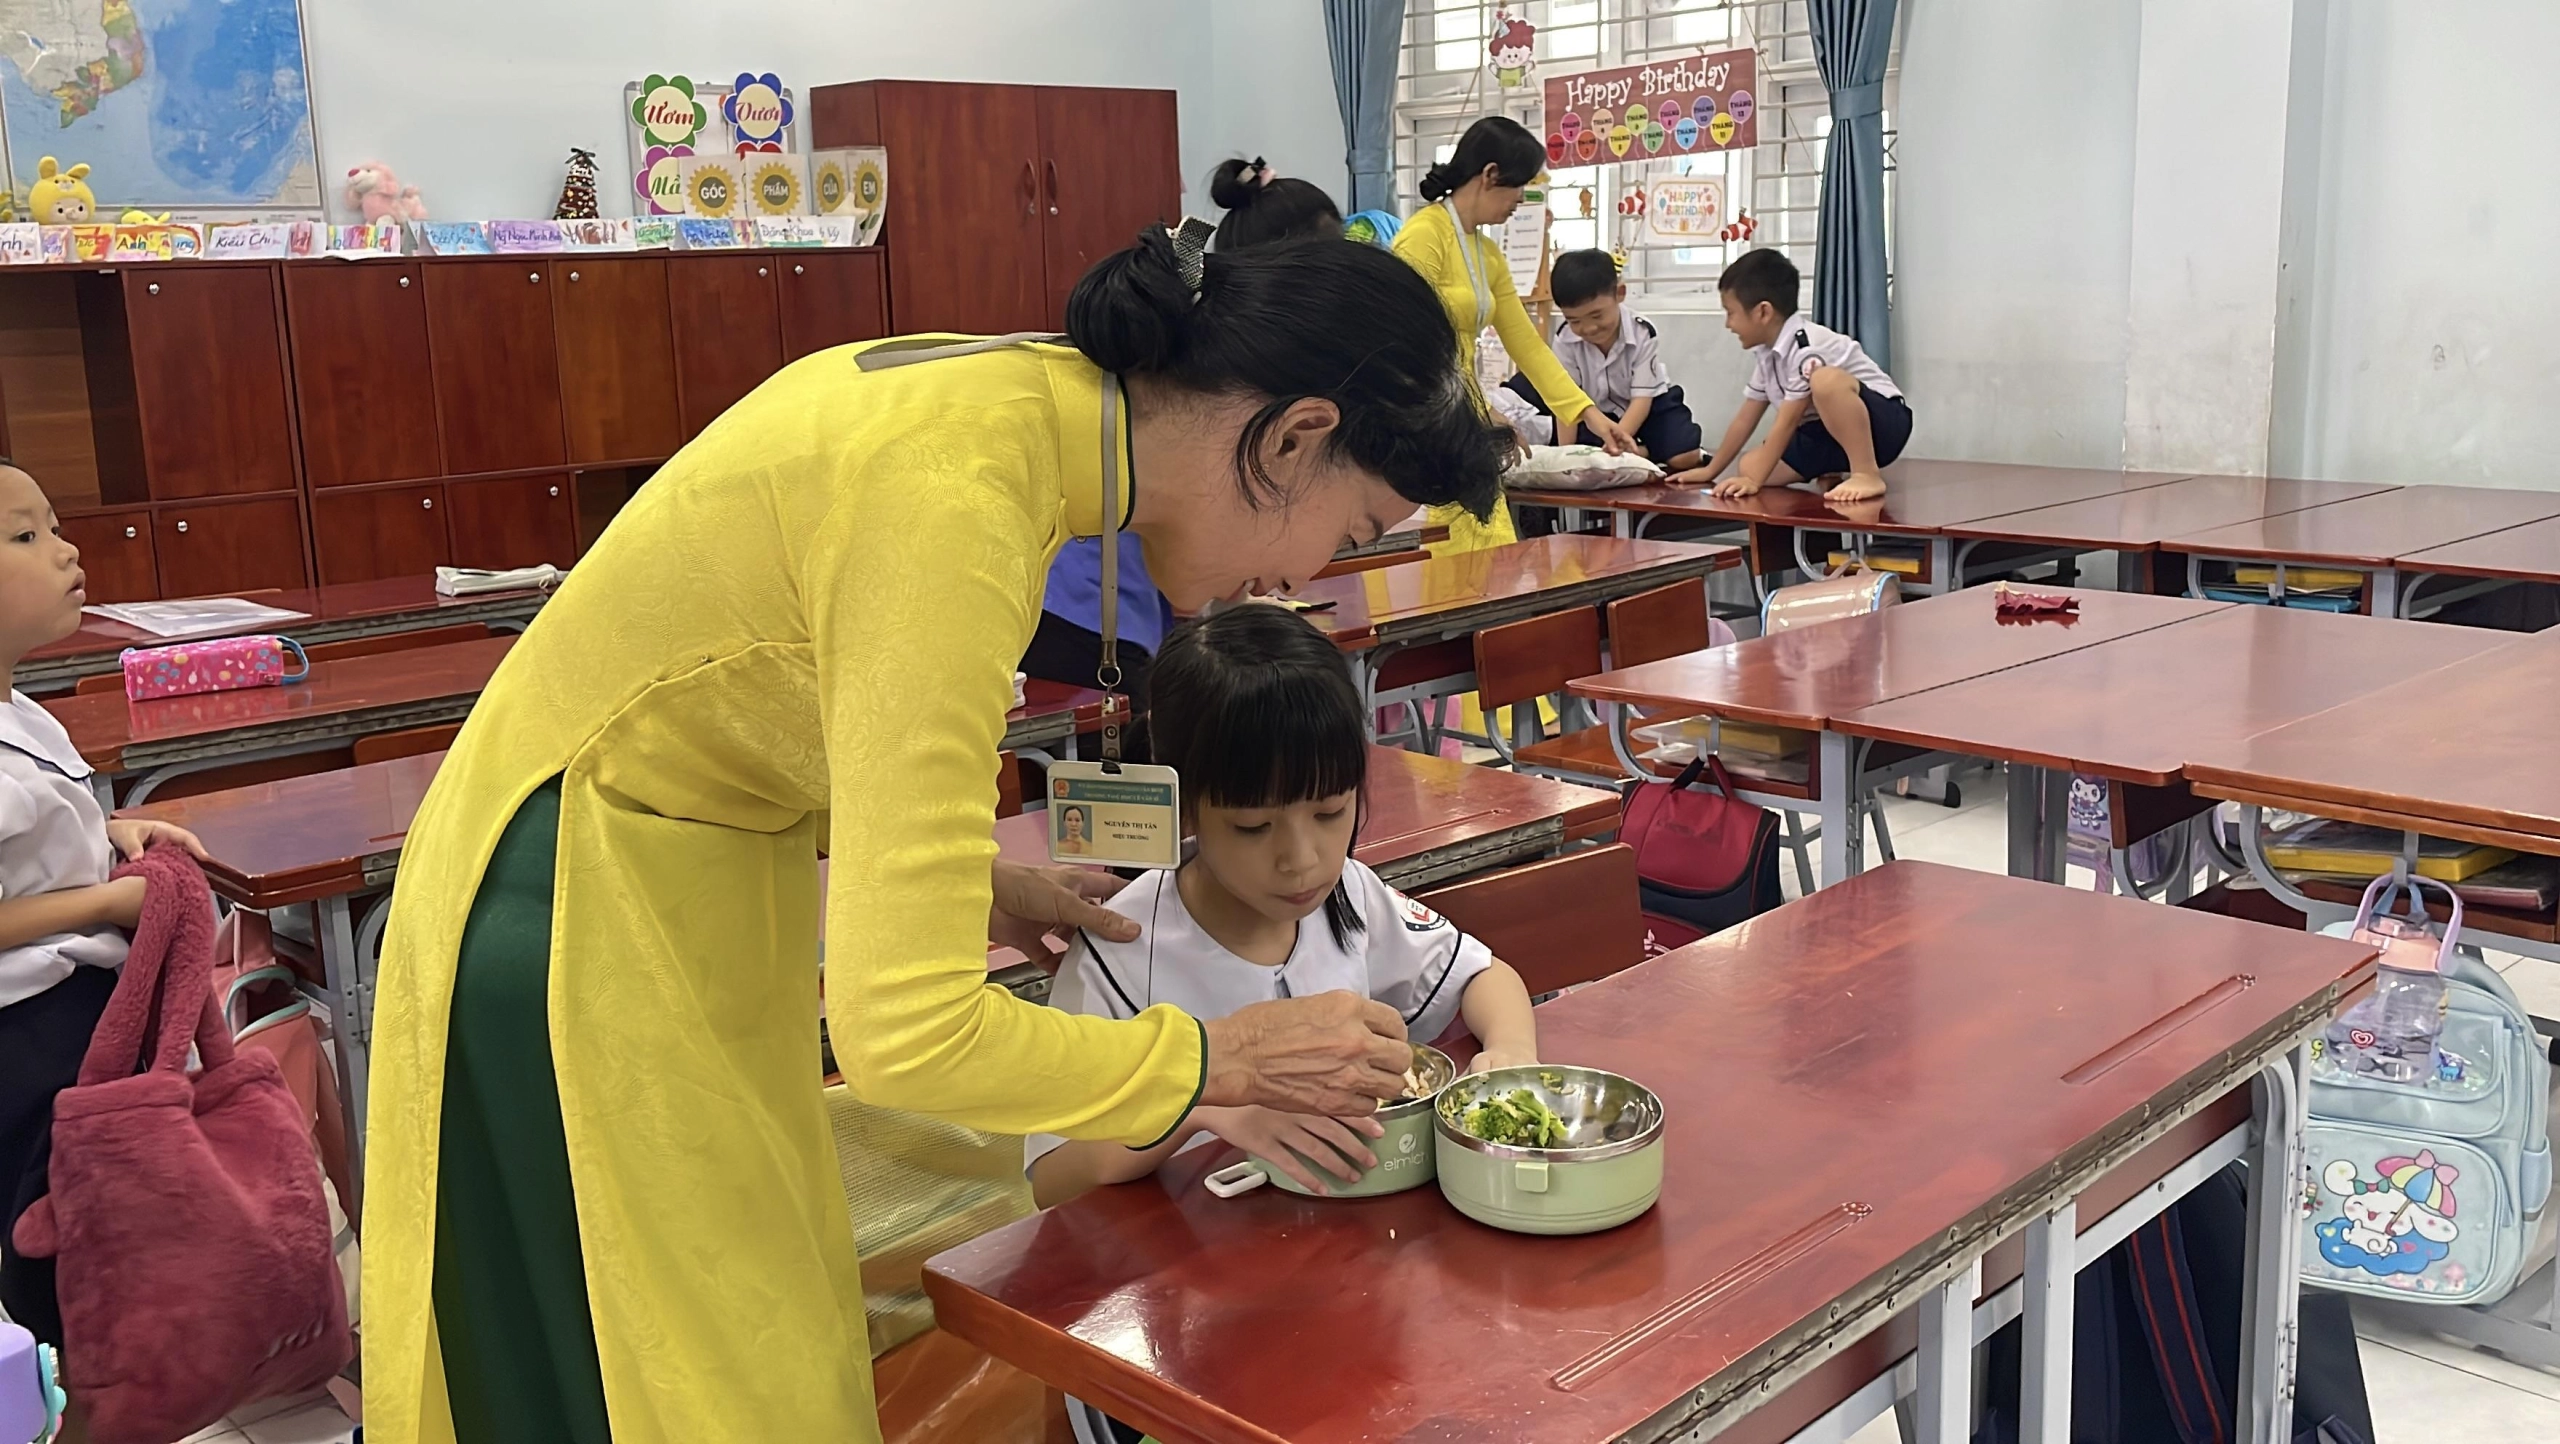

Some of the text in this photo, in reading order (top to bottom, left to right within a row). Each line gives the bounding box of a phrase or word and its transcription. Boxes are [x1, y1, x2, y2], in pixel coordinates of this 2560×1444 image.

[1565, 57, 1730, 112] Happy Birthday
[700, 183, 727, 200] GÓC
[863, 181, 876, 195] EM
[1669, 191, 1704, 203] HAPPY
[1666, 204, 1708, 216] BIRTHDAY
